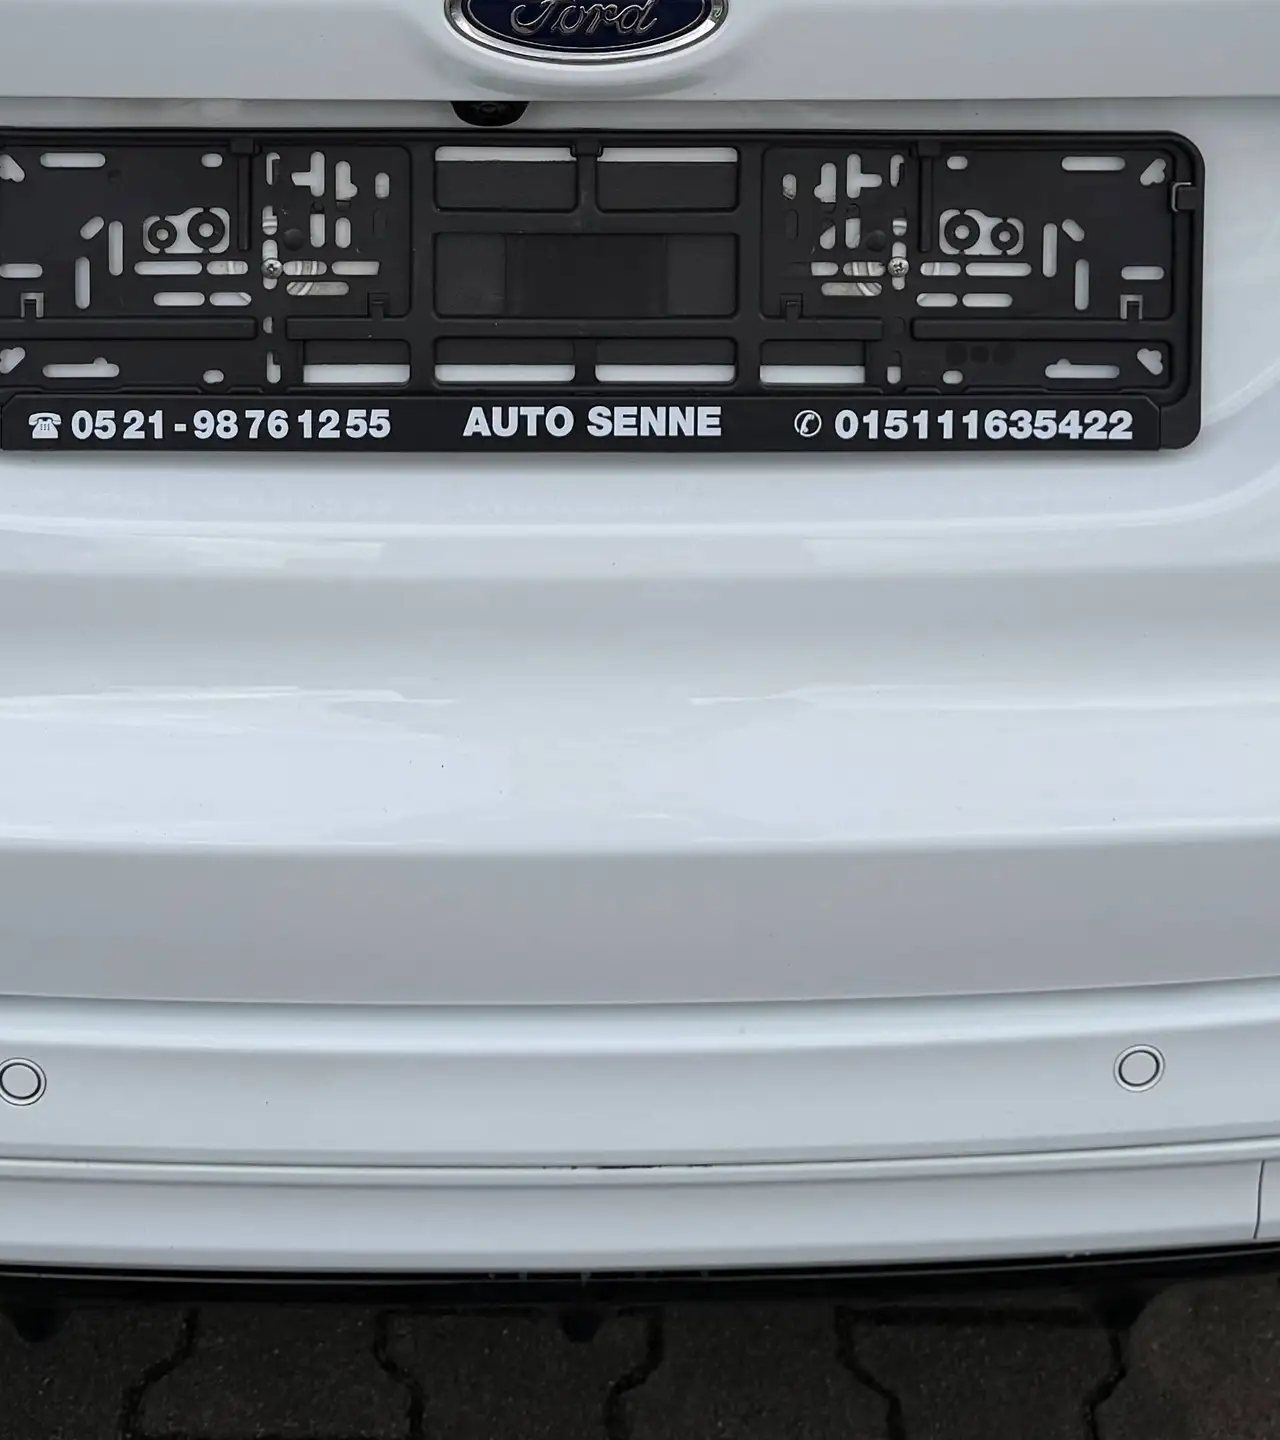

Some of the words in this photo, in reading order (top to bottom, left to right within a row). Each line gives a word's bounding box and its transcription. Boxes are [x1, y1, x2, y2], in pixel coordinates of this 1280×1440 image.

[463, 406, 575, 437] AUTO
[586, 406, 722, 437] SENNE
[834, 409, 1133, 440] 015111635422
